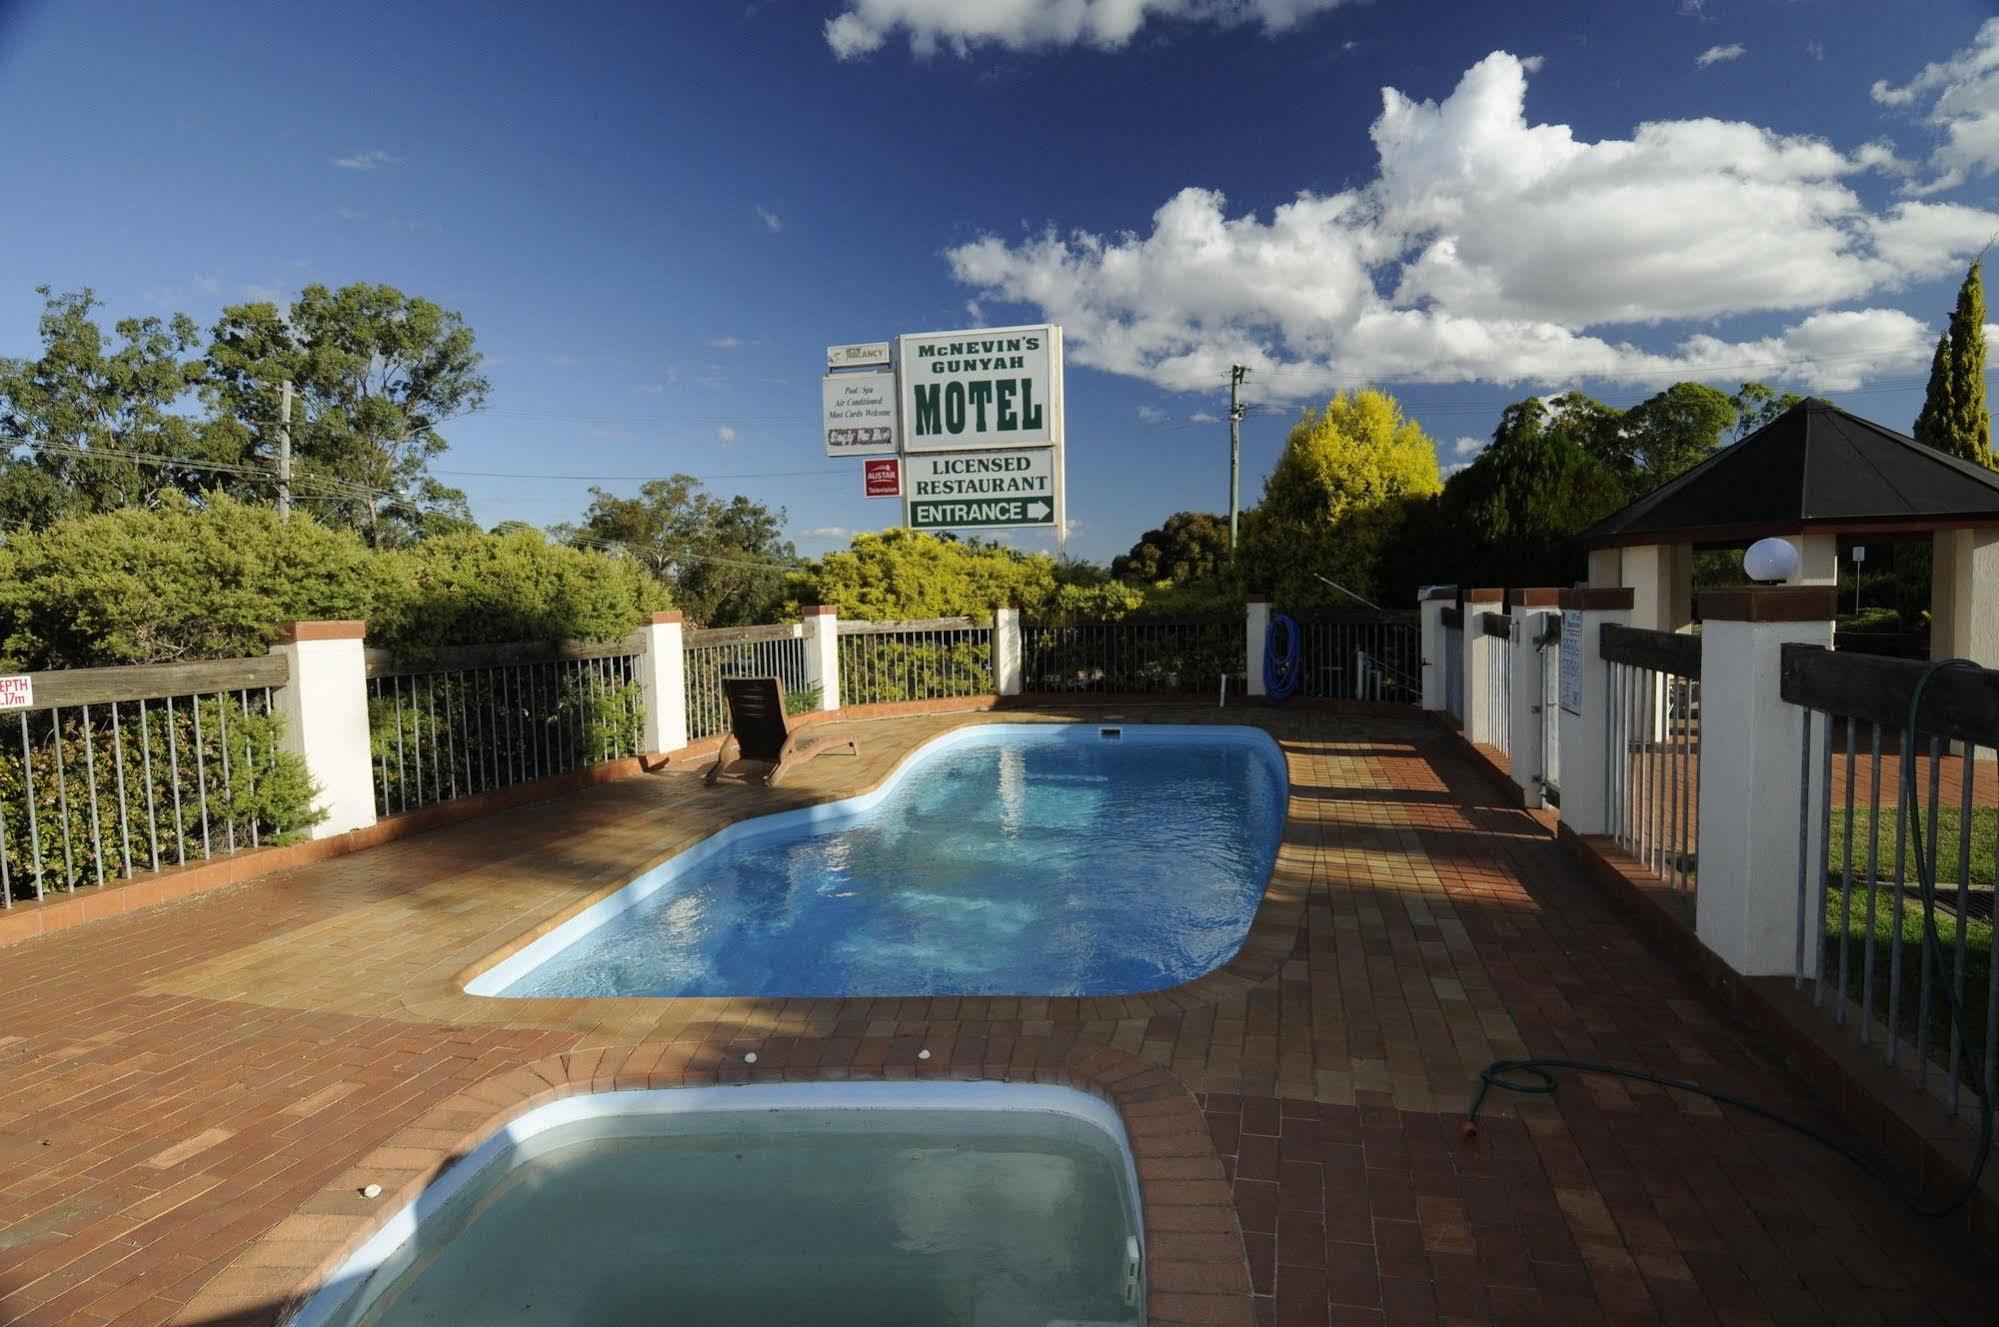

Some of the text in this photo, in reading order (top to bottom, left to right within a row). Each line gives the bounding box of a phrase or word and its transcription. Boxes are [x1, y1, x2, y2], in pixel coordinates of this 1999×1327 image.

[931, 355, 1025, 374] GUNYAH
[914, 378, 1043, 436] MOTEL
[932, 456, 1031, 475] LICENSED
[868, 471, 896, 480] AUSTAR
[916, 475, 1048, 496] RESTAURANT
[916, 502, 1023, 523] ENTRANCE
[0, 678, 28, 692] EPTH
